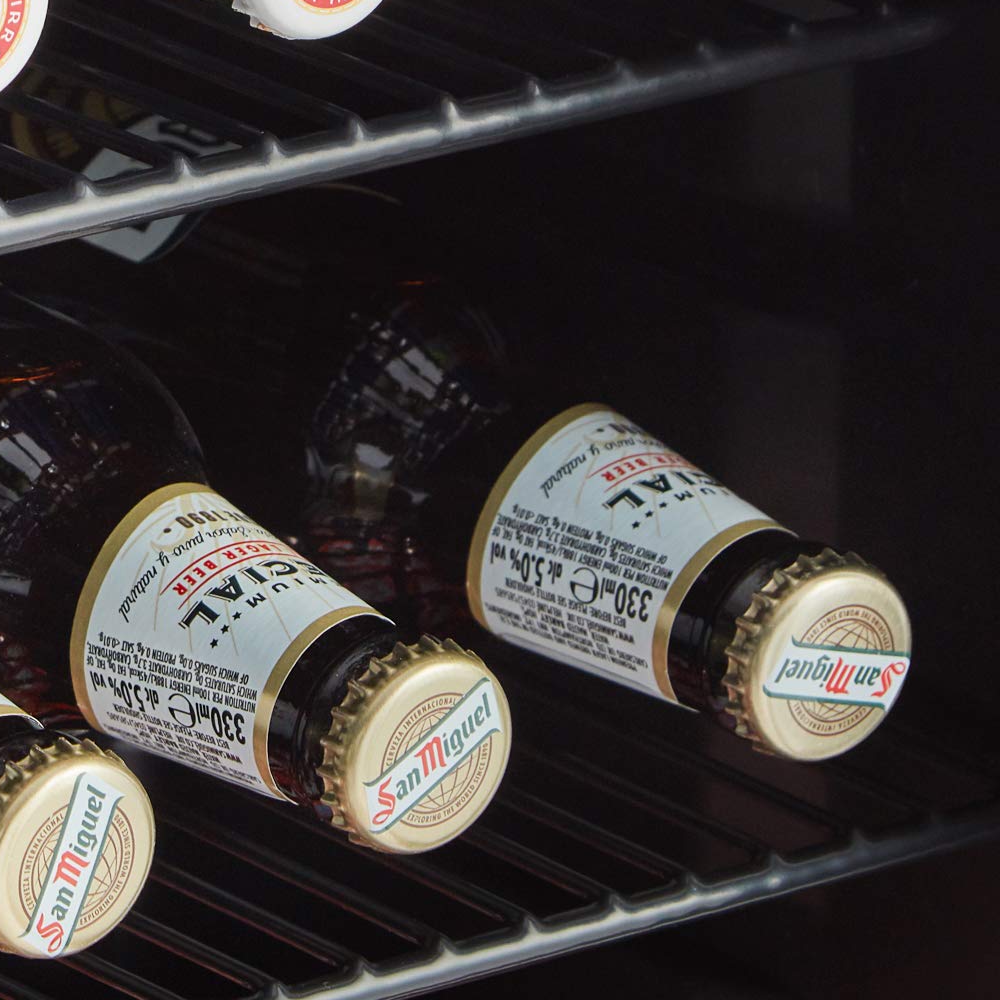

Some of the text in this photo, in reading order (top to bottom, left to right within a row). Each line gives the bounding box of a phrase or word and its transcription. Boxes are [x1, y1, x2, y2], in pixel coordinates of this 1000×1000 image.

[540, 455, 588, 498] natural
[172, 560, 216, 597] BEER
[490, 543, 507, 564] vol
[119, 565, 157, 624] natural
[90, 671, 108, 693] vol
[775, 655, 906, 697] San Miguel
[386, 698, 457, 766] CERVEZA INTERNACIONAL
[372, 693, 491, 825] San Miguel
[442, 805, 455, 817] THE
[455, 785, 475, 806] WORLD
[24, 813, 64, 912] CERVEZA INTERNACIONAL
[36, 784, 106, 953] San Miguel
[79, 894, 114, 925] EXPLORING
[113, 882, 121, 894] THE
[119, 852, 132, 878] WORLD
